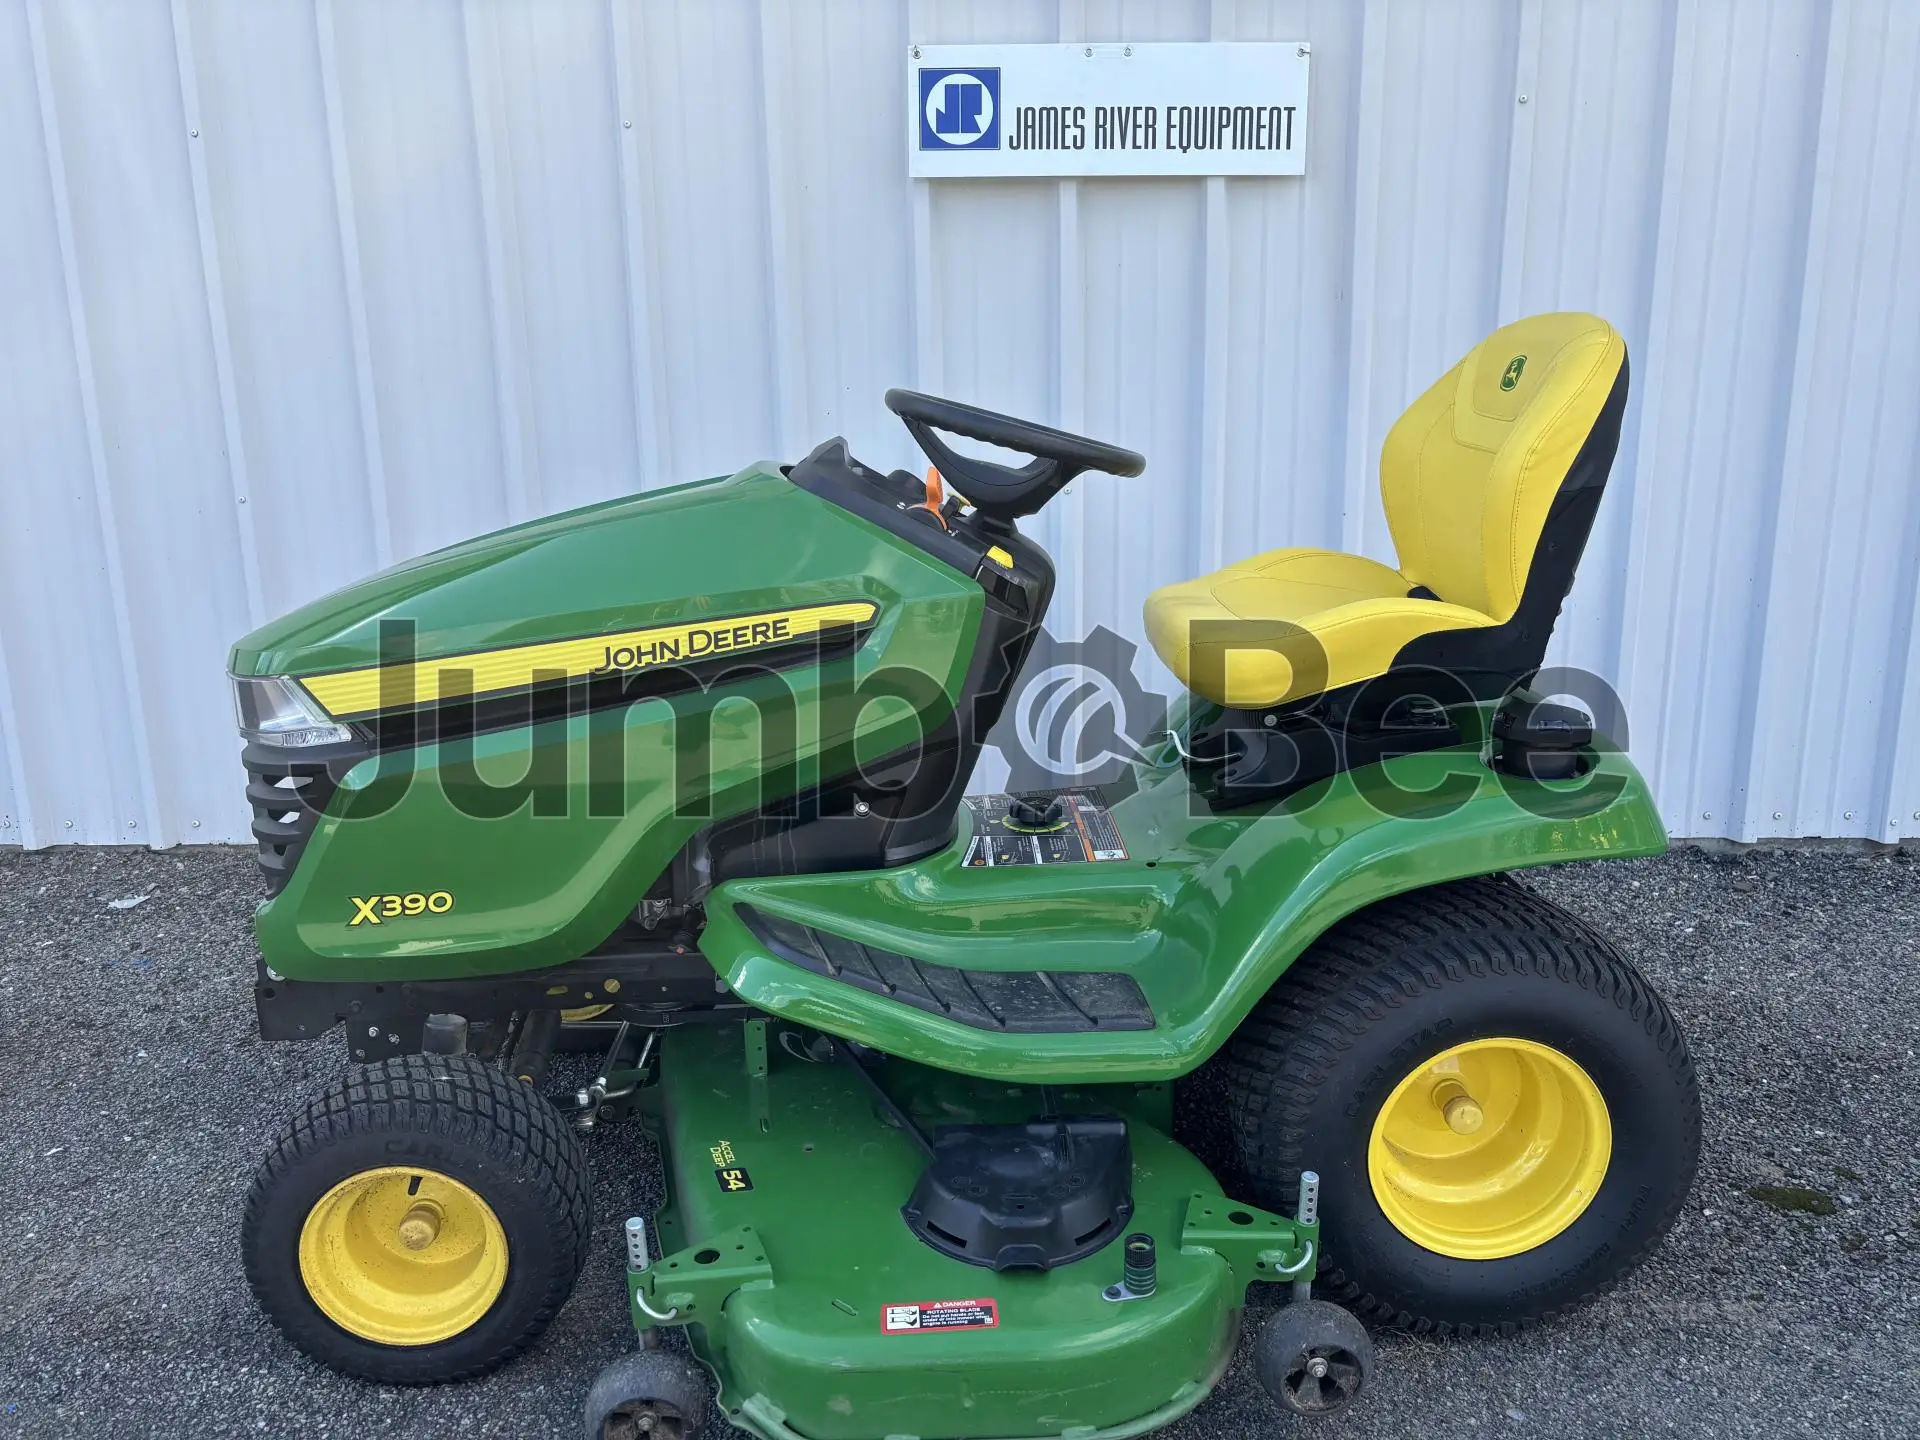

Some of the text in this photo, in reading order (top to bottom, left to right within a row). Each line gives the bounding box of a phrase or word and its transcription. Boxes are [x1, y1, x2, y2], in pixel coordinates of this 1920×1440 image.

[1008, 106, 1297, 154] JAMES RIVER EQUIPMENT
[594, 617, 791, 674] JOHN DEERE
[345, 889, 455, 927] X390
[709, 1146, 726, 1168] DEEP
[718, 1139, 736, 1164] ACCEL
[722, 1169, 746, 1190] 54
